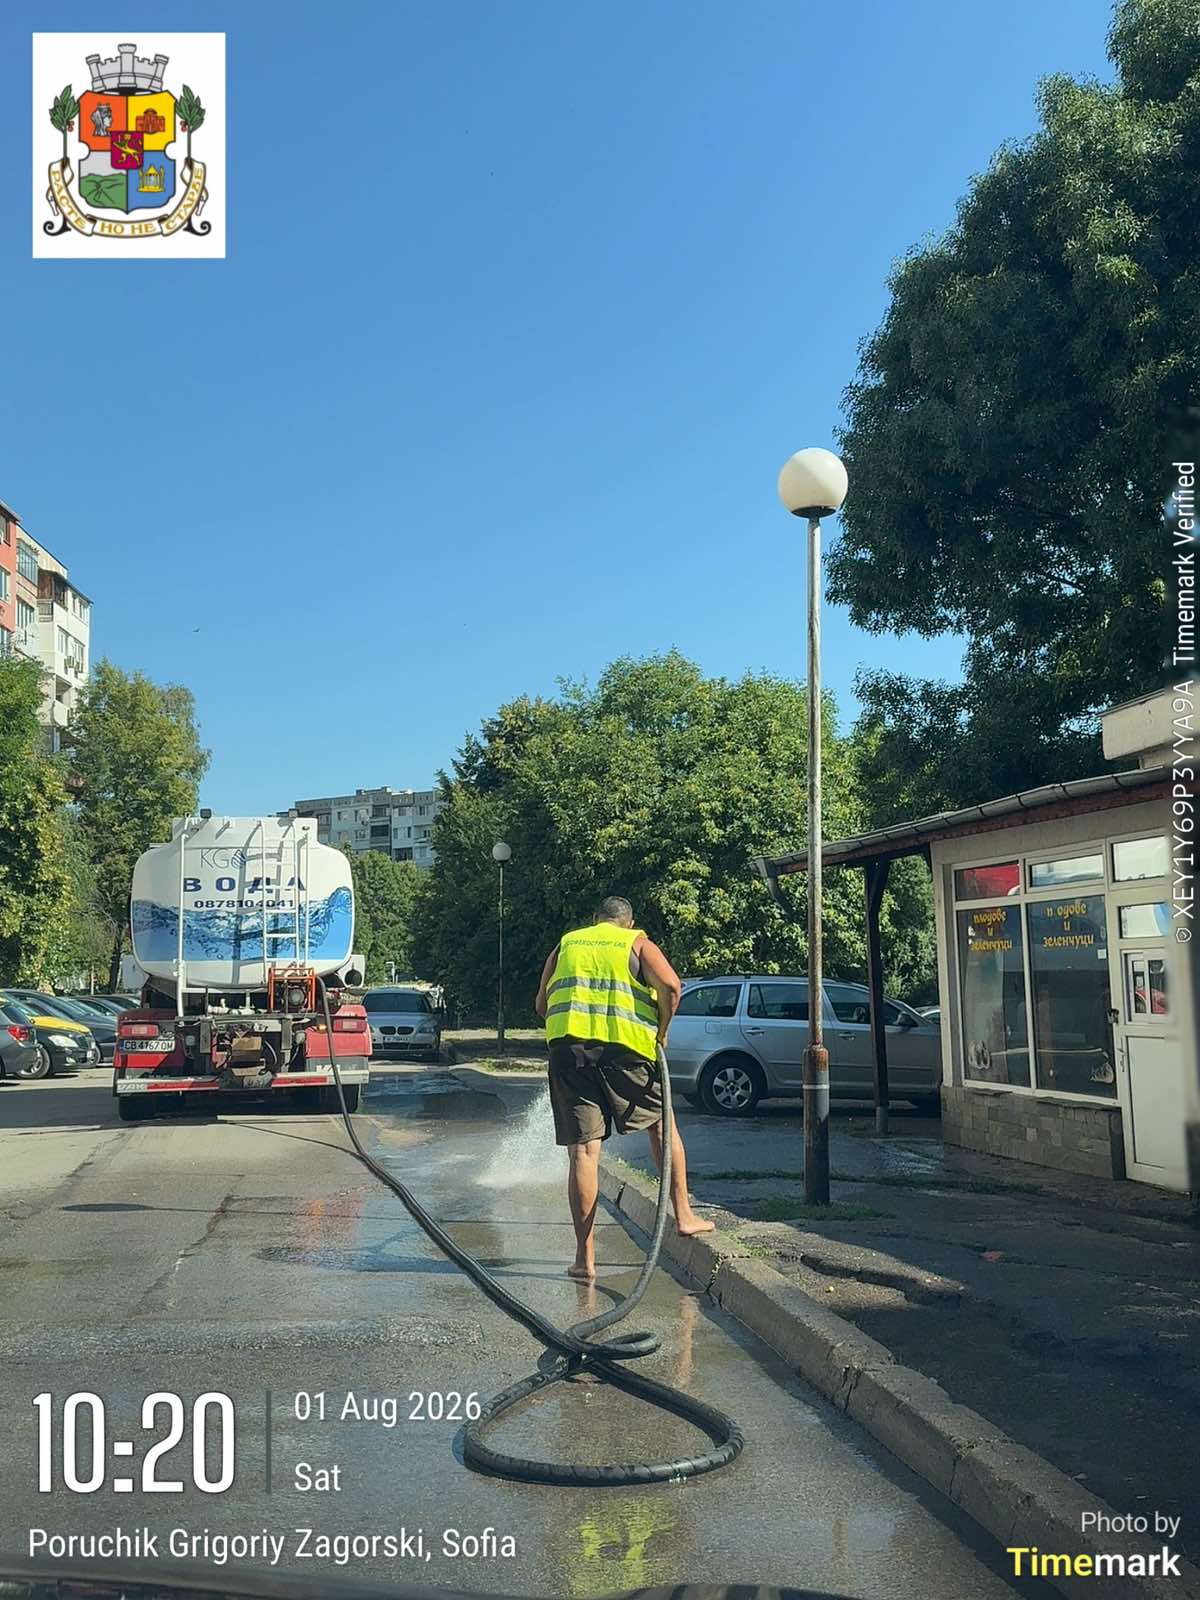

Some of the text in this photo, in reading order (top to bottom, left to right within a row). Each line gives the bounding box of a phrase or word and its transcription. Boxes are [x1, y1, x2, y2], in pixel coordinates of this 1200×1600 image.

[1064, 921, 1071, 931] и
[987, 927, 994, 936] и
[1043, 934, 1094, 949] зеленчуци
